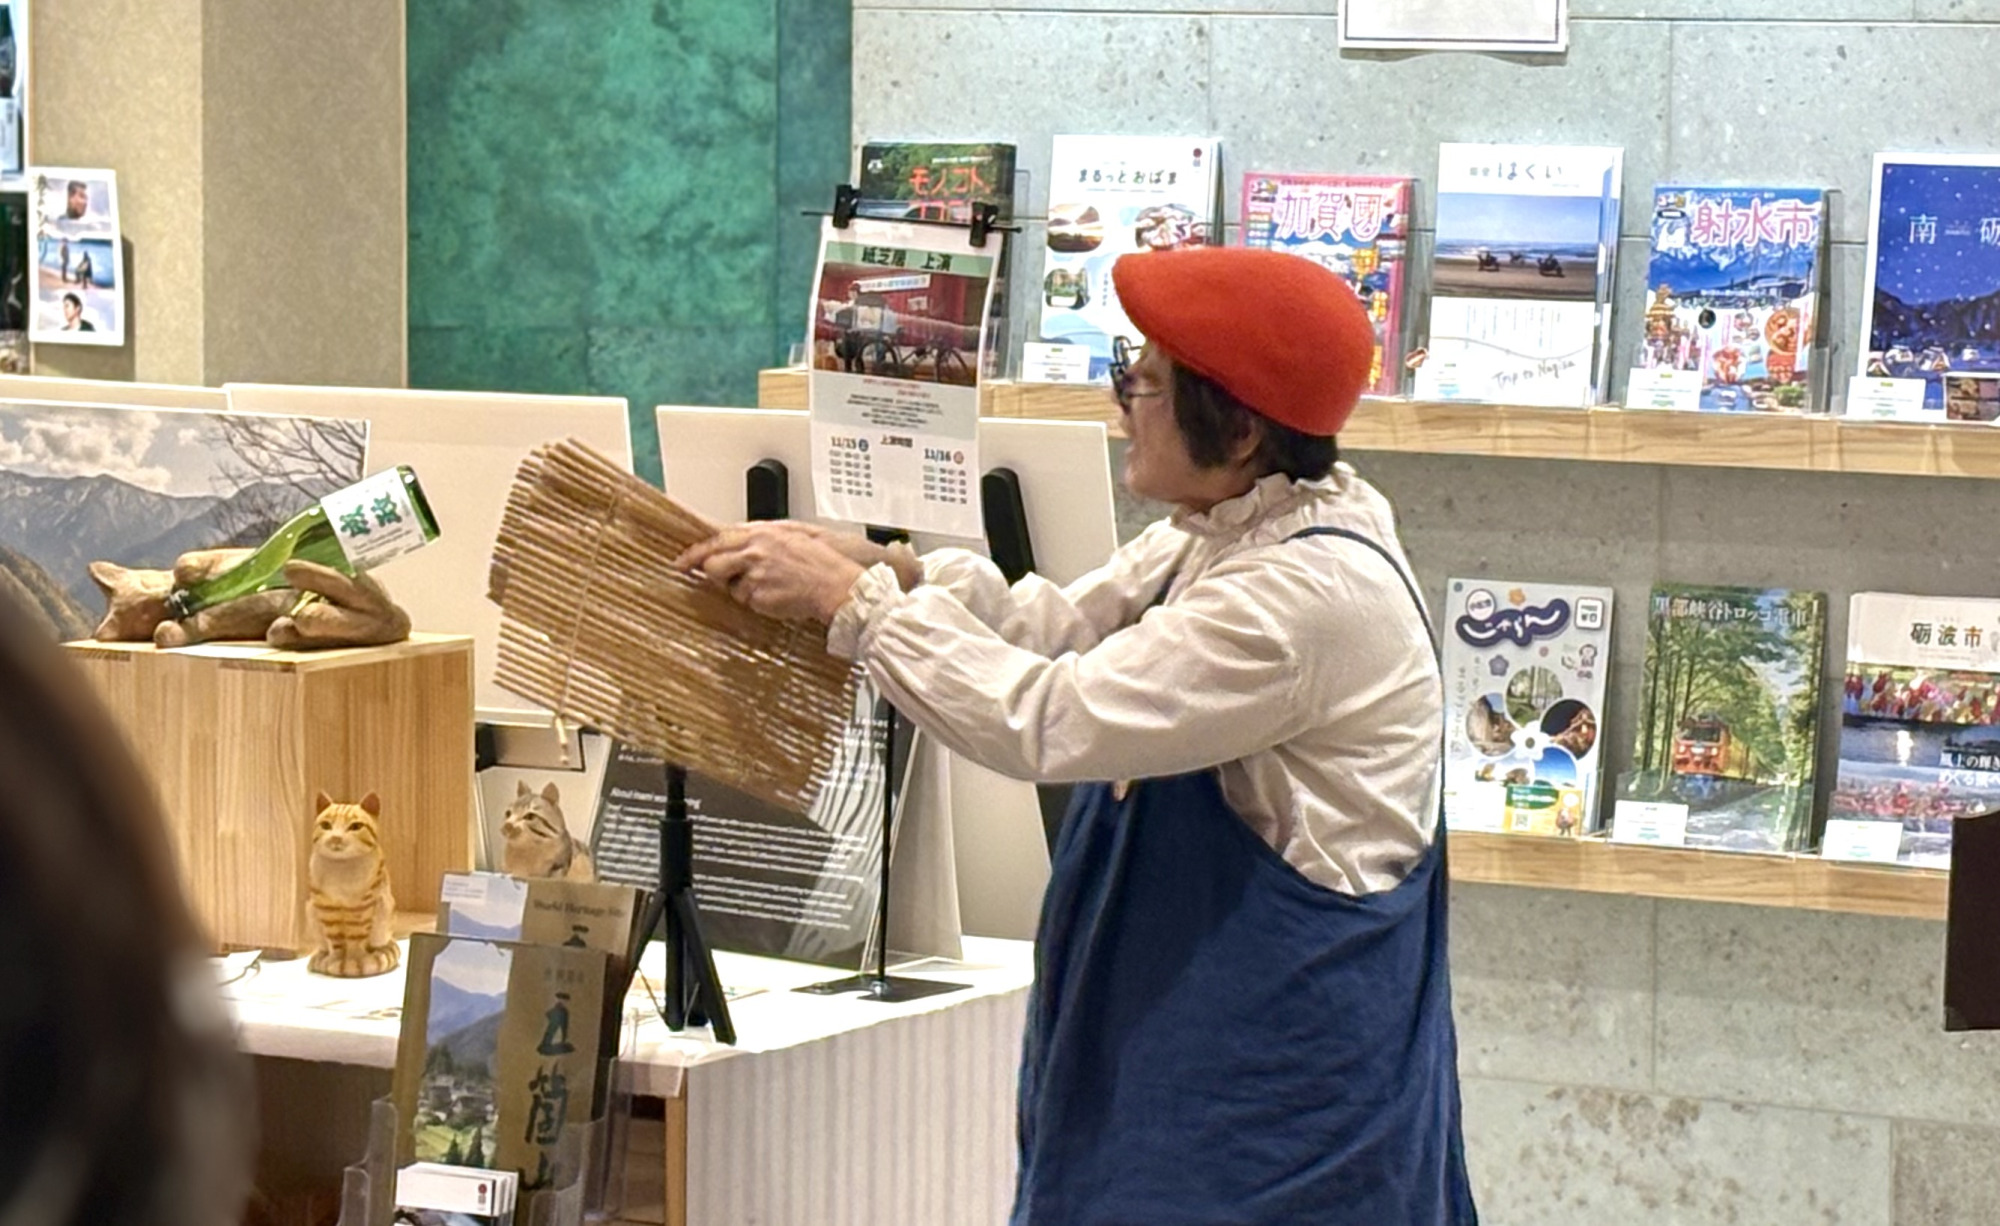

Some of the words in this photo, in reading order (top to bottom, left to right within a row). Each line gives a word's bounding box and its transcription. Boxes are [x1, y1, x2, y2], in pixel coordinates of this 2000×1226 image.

[1277, 190, 1383, 241] 加賀國
[1692, 199, 1817, 247] 射水市
[1909, 212, 1938, 245] 南
[861, 245, 907, 267] 紙芝居
[920, 252, 954, 272] 上演
[1462, 610, 1562, 640] じゃらん
[1910, 622, 1984, 649] 砺波市
